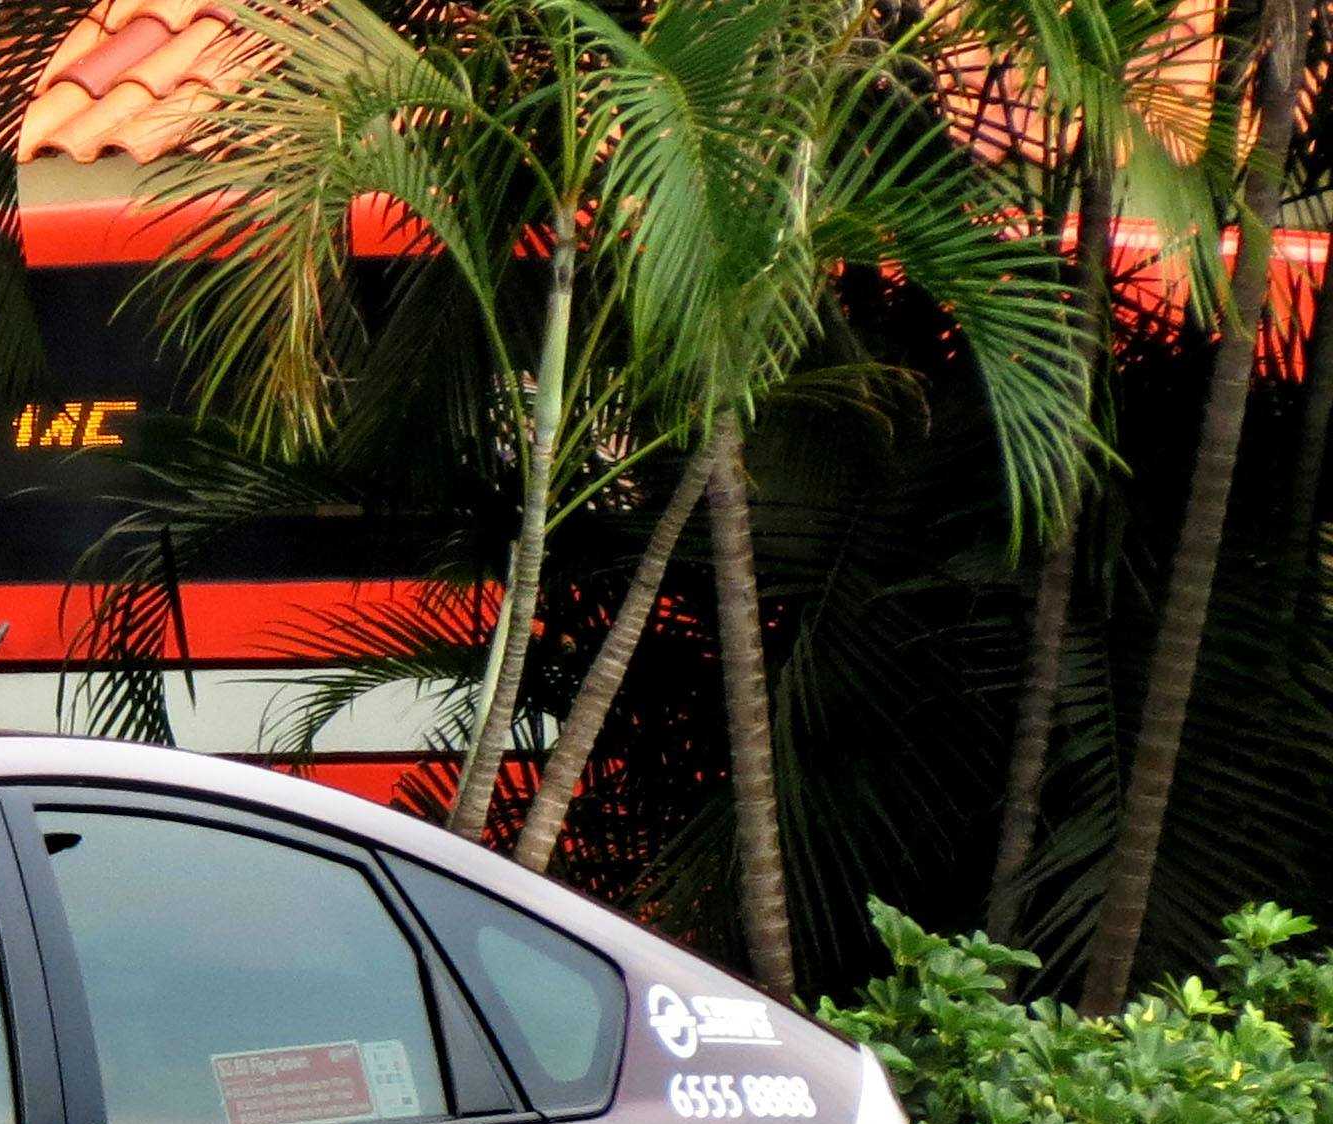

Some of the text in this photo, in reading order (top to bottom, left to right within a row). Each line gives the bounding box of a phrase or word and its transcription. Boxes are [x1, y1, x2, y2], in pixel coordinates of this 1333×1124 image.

[691, 996, 775, 1038] SMRT
[670, 1073, 817, 1118] 6555 8888
